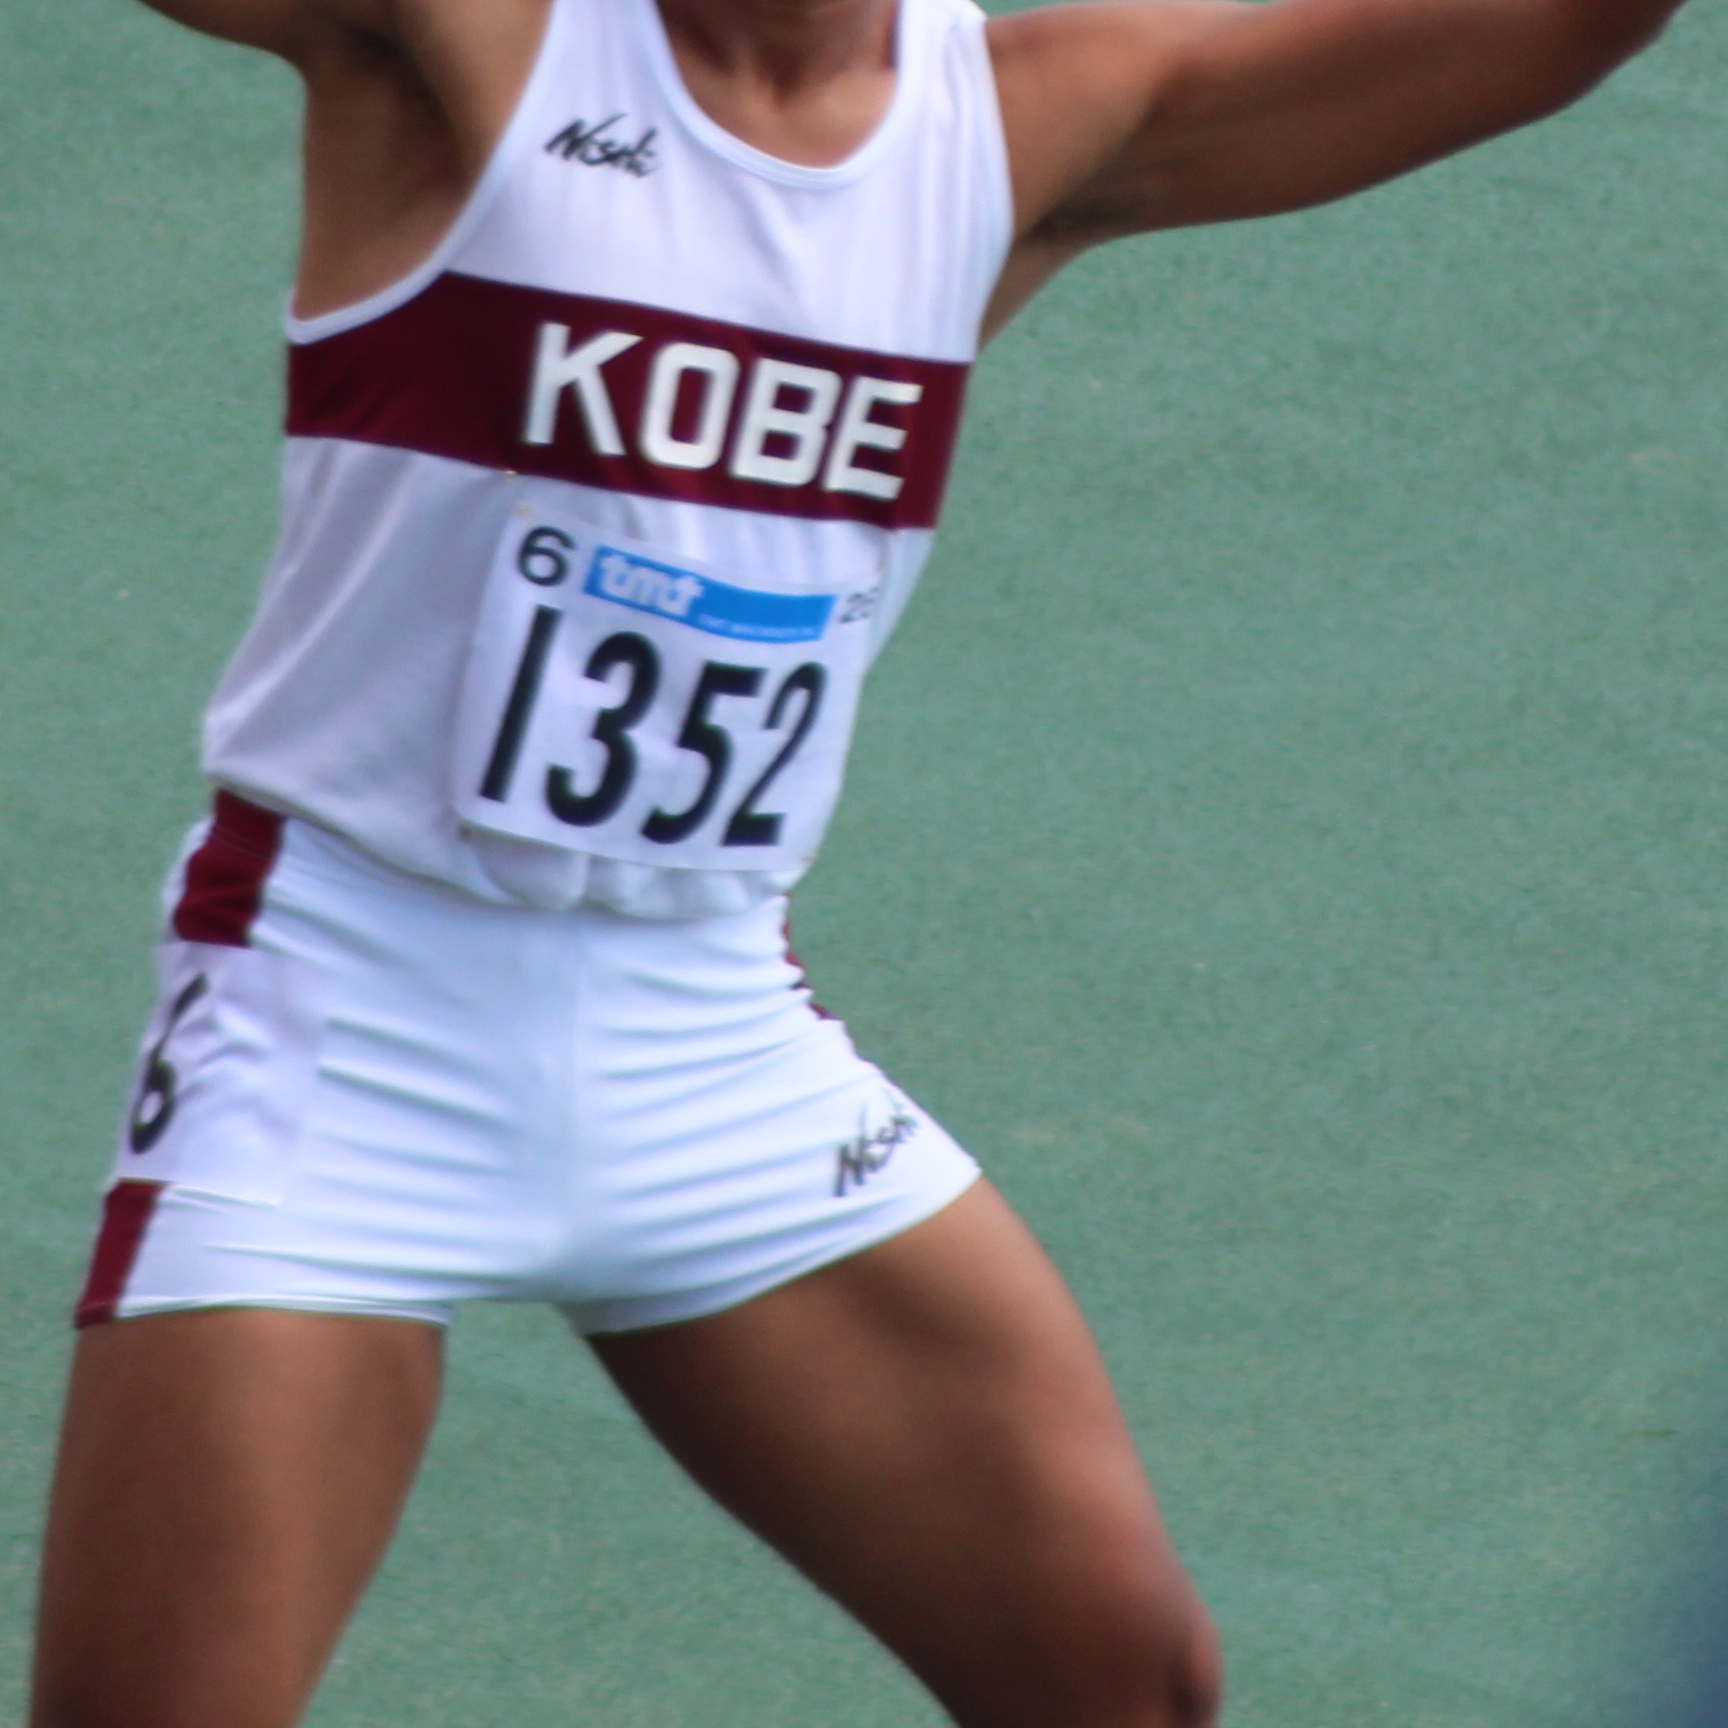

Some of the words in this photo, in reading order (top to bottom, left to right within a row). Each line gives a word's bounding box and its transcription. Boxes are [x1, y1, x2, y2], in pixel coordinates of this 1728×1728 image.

[522, 321, 923, 502] KOBE
[516, 525, 576, 587] 6
[478, 606, 828, 847] 1352
[129, 971, 209, 1155] 6
